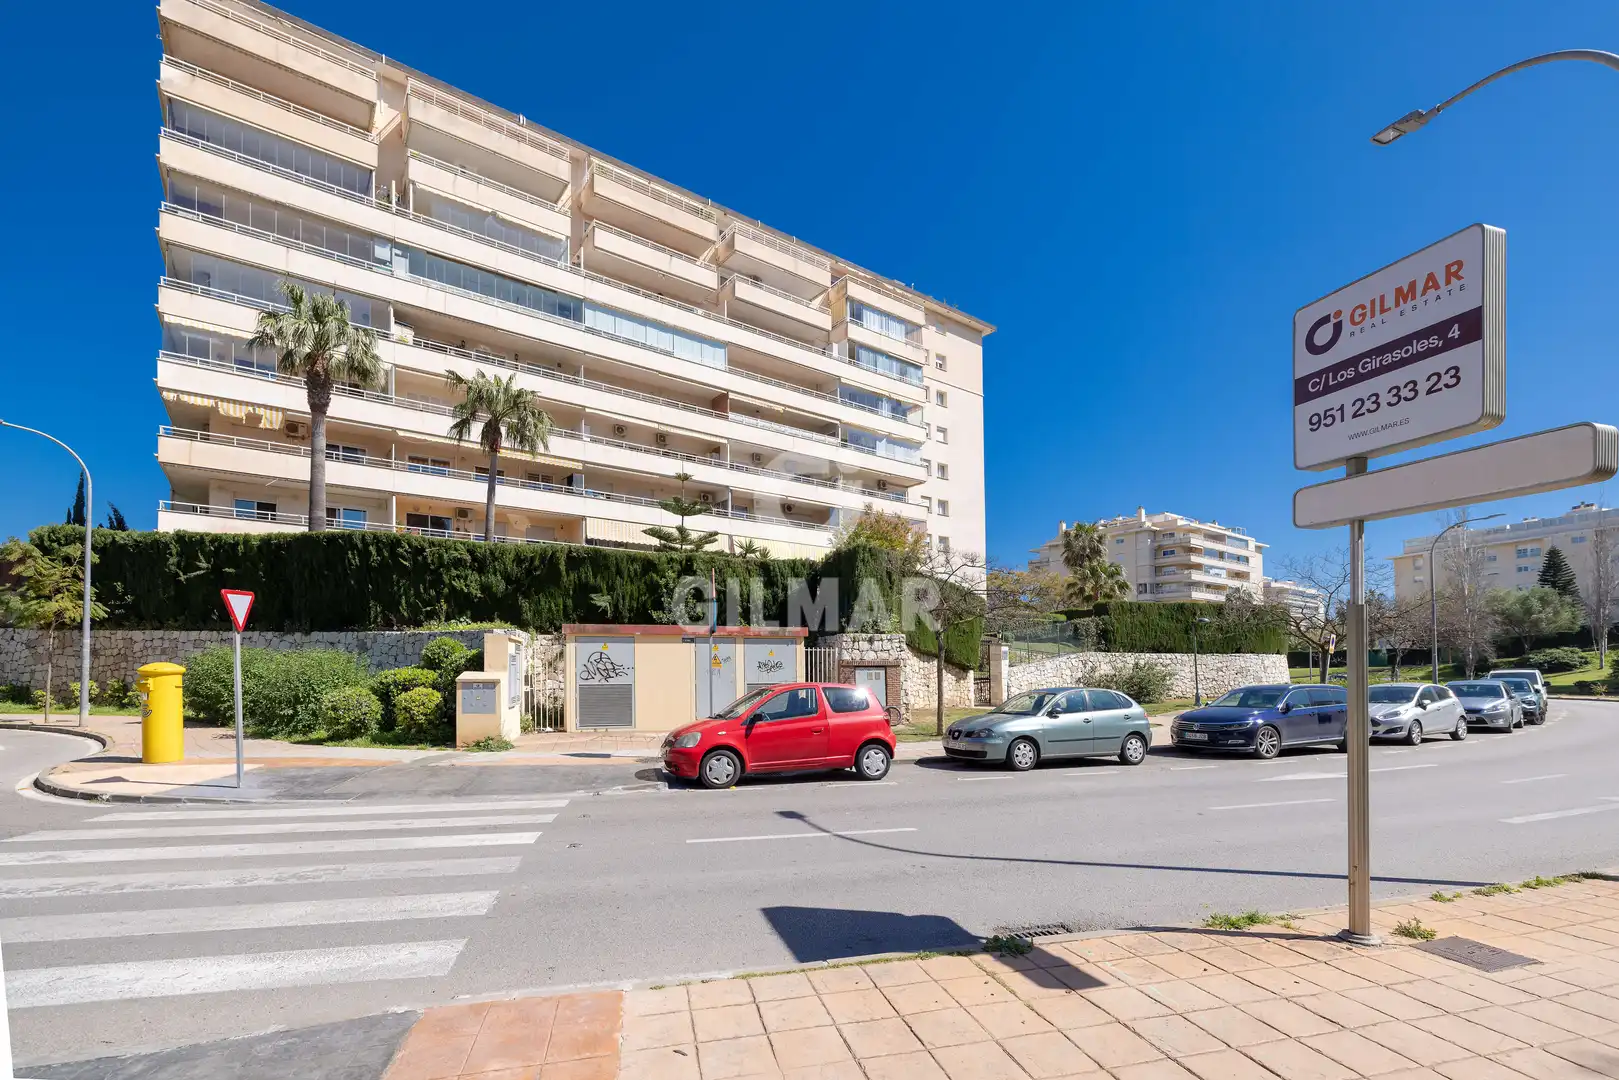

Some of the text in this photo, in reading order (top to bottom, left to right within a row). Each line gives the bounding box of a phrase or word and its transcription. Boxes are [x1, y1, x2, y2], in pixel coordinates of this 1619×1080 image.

[1349, 260, 1464, 326] GILMAR
[1350, 284, 1466, 337] REAL ESTATE
[1308, 324, 1460, 392] C/ Los Girasoles, 4
[1308, 365, 1461, 433] 951 23 33 23
[1348, 418, 1410, 441] WWW.GILMAR.ES
